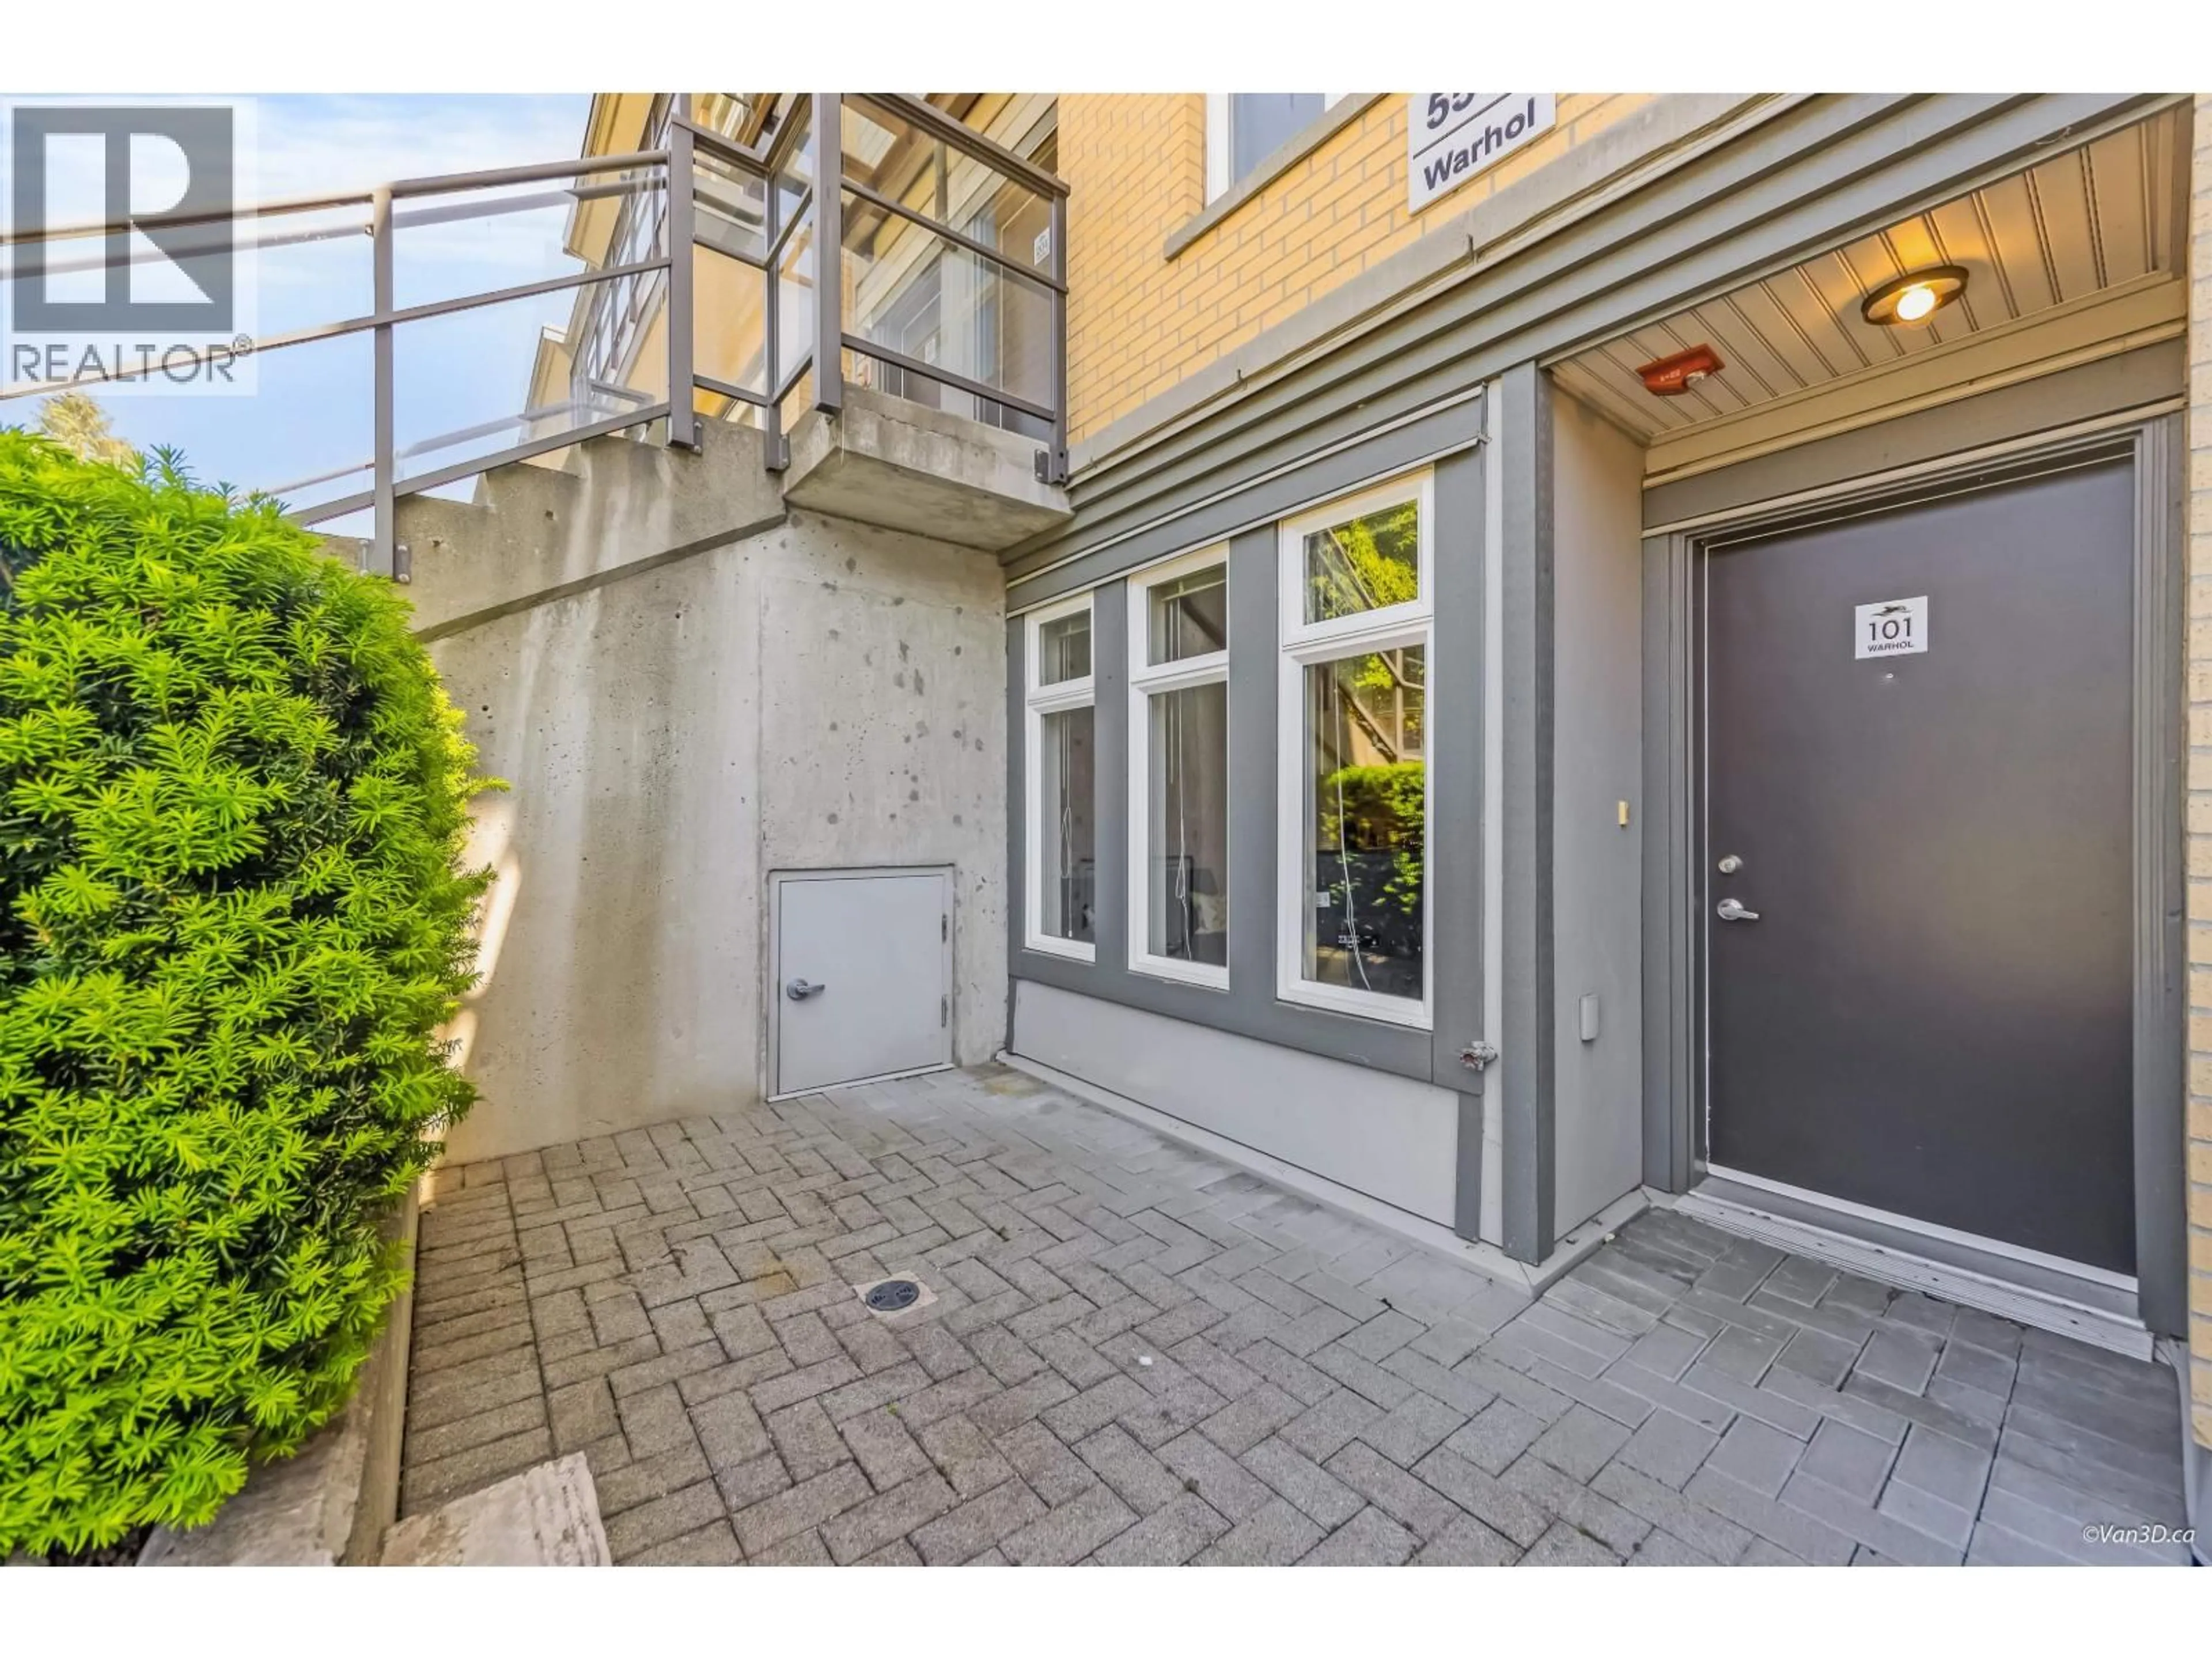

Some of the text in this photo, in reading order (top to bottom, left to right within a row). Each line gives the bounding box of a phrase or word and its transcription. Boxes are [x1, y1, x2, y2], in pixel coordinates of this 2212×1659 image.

[1423, 97, 1535, 190] Warhol
[1869, 618, 1911, 641] 101
[1868, 641, 1914, 652] WARHOL
